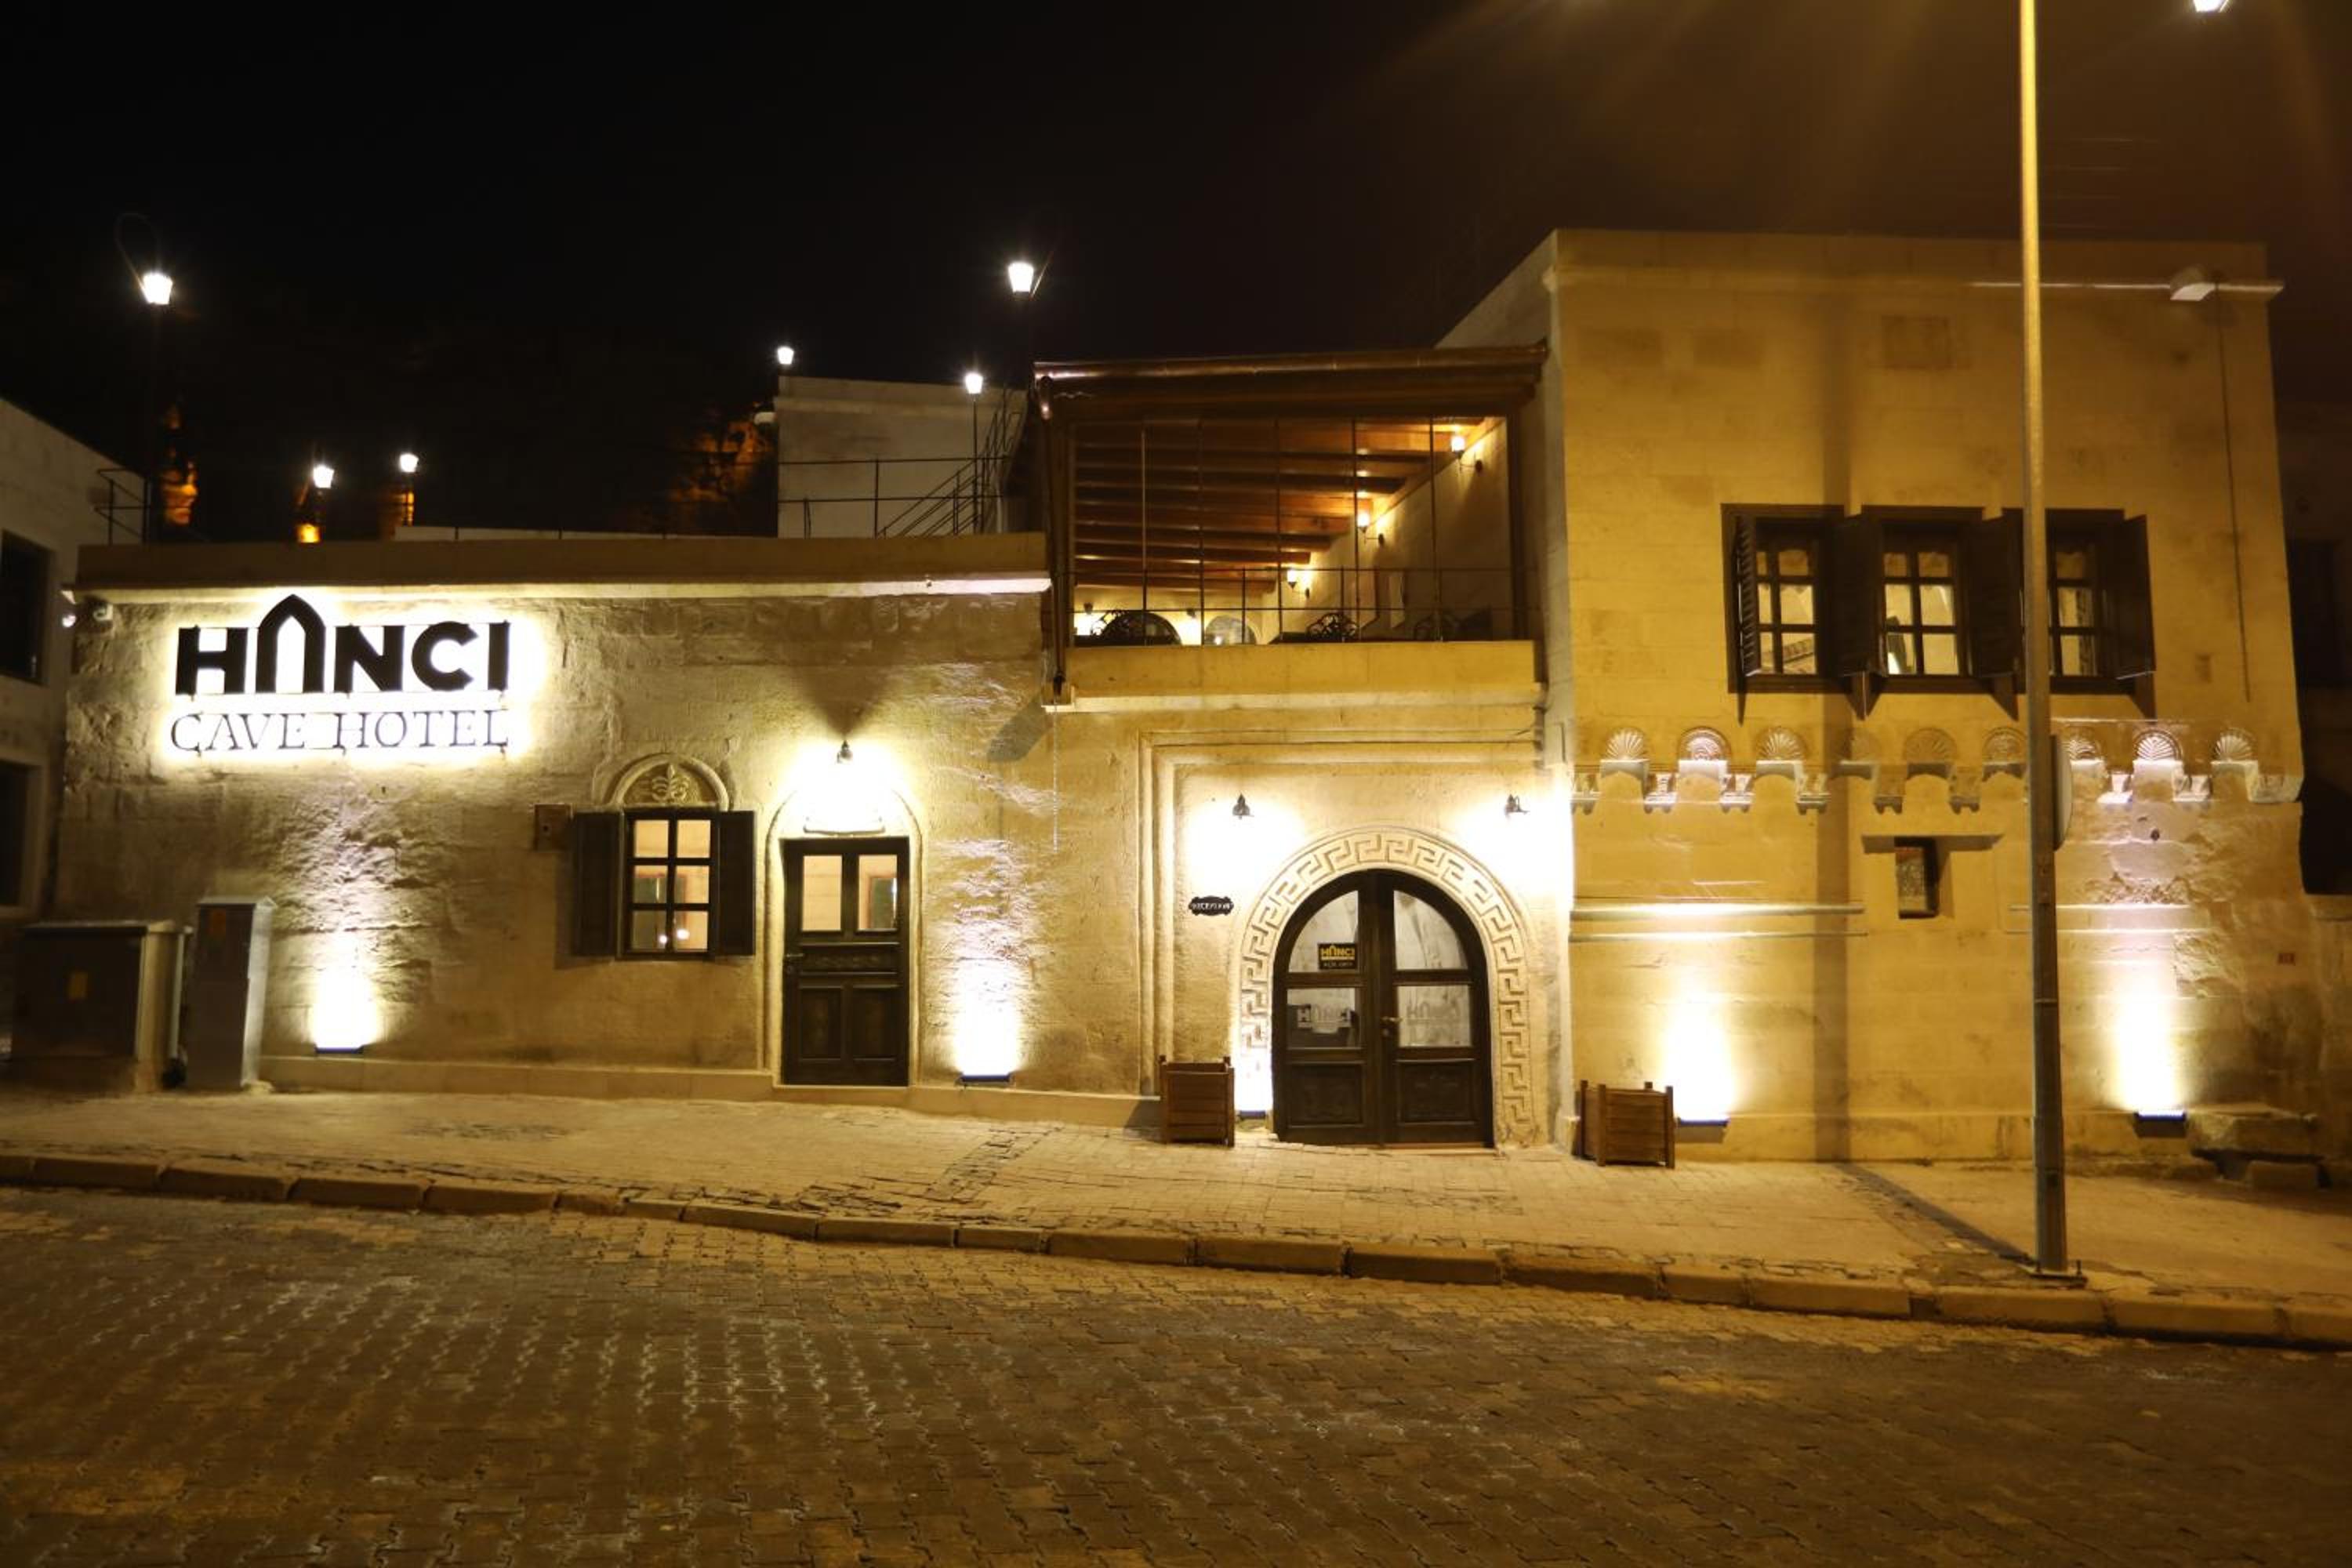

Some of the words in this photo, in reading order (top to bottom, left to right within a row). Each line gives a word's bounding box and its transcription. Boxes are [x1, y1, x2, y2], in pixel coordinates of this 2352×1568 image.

[175, 593, 511, 695] HANCI
[170, 712, 307, 752] CAVE
[332, 709, 510, 750] HOTEL
